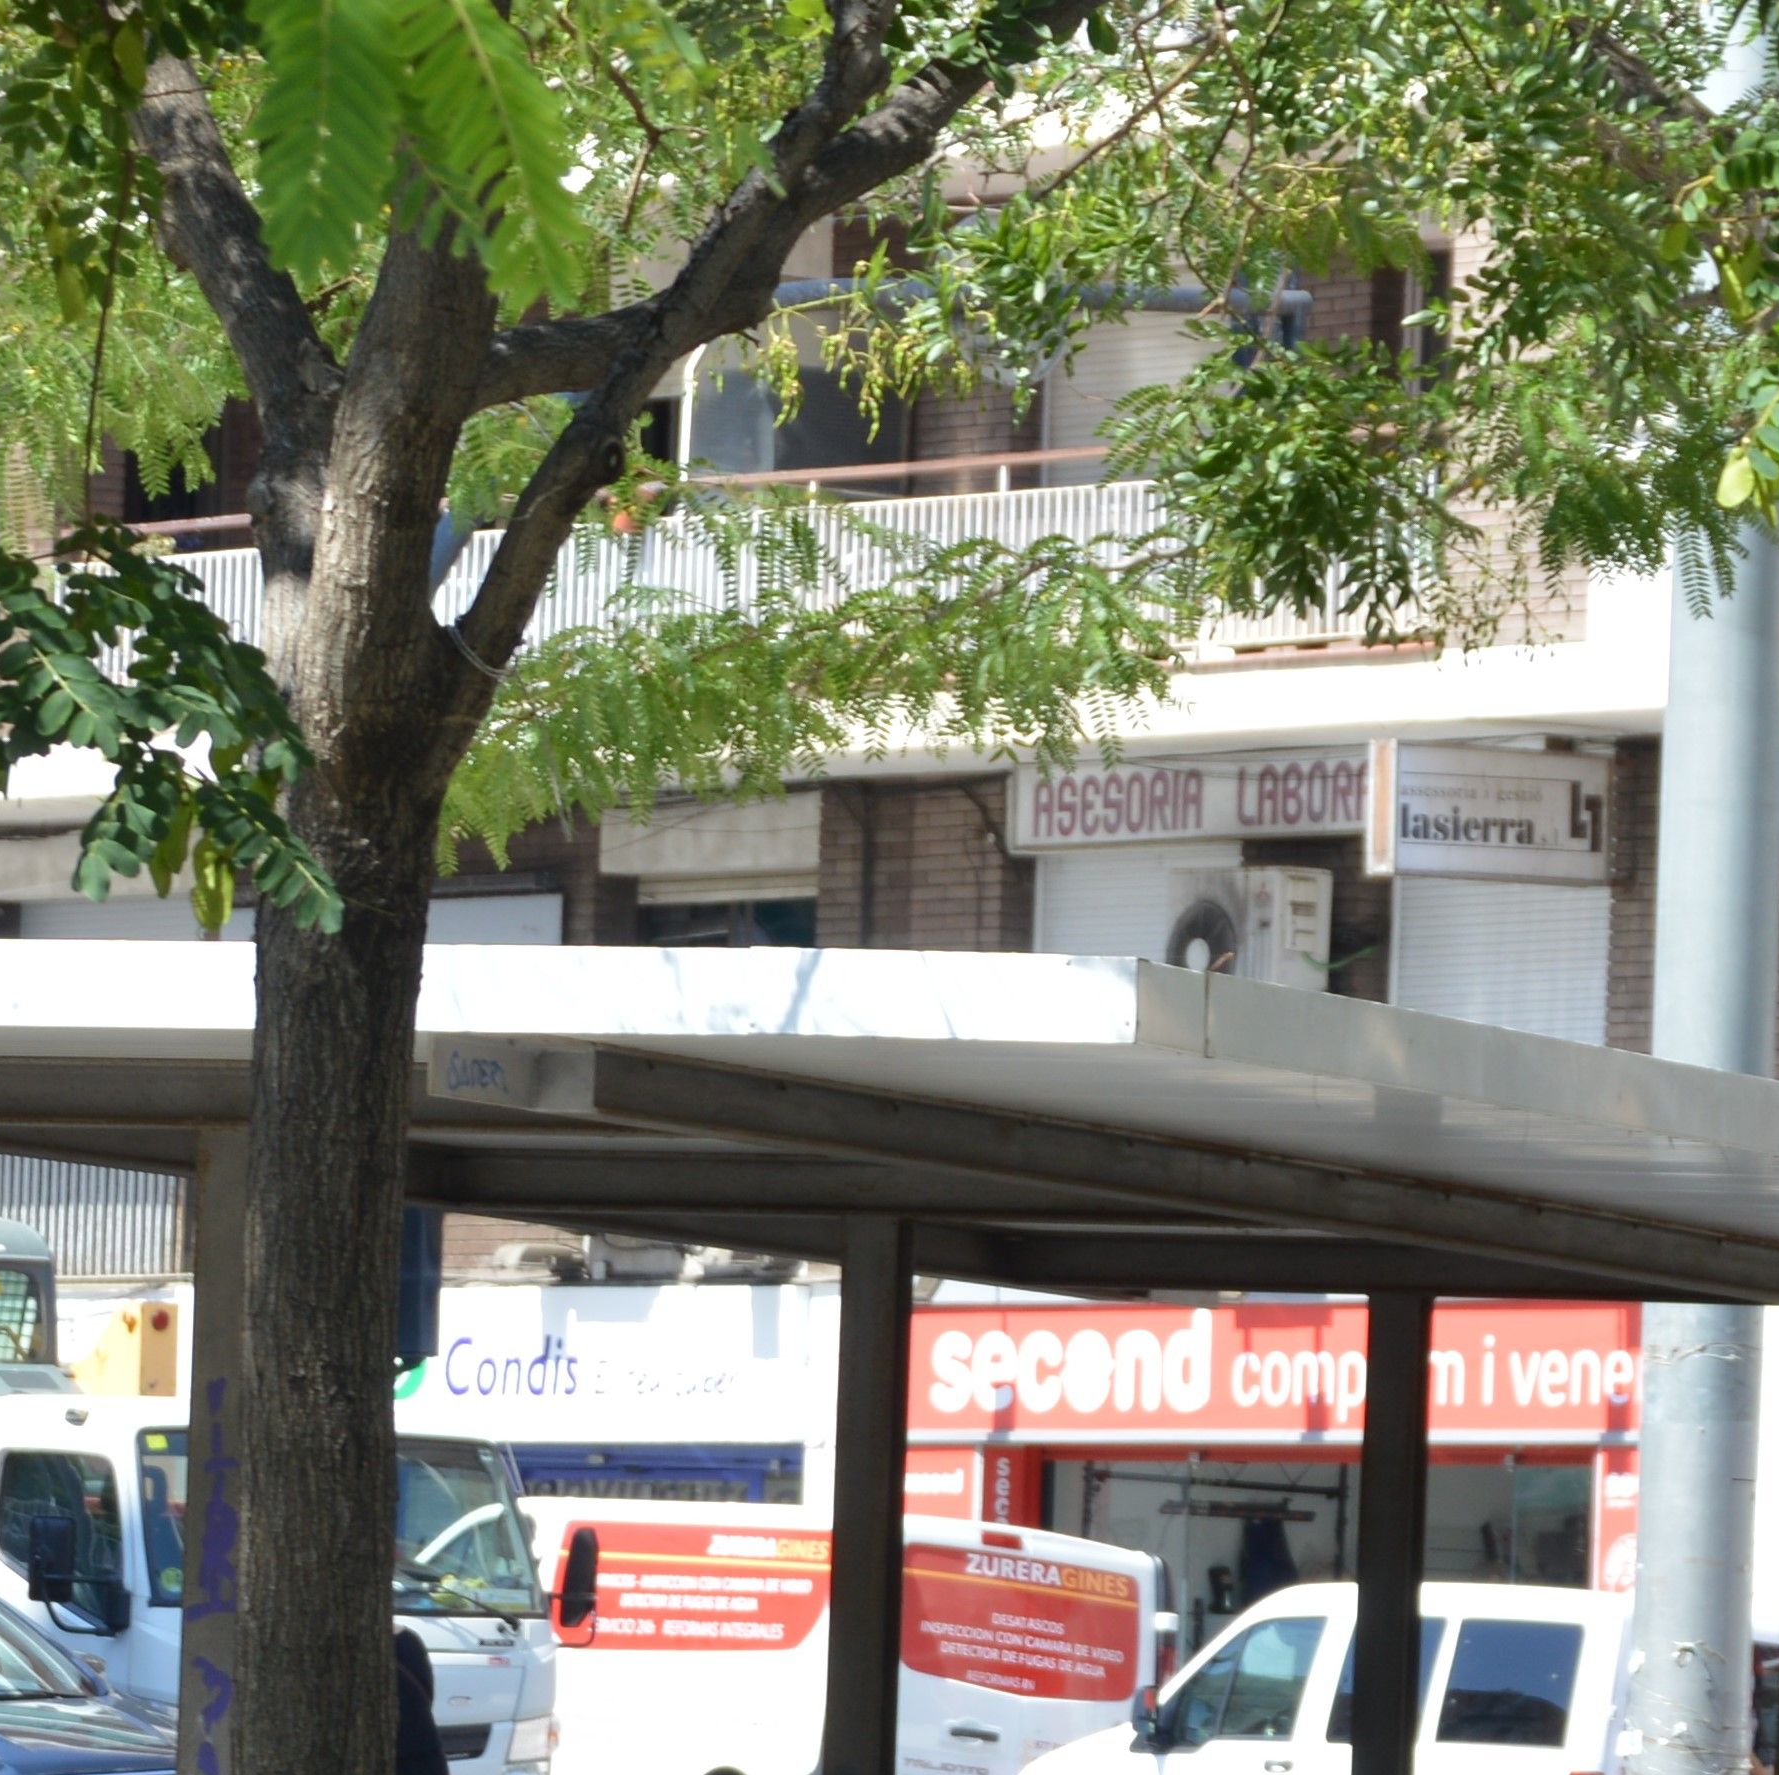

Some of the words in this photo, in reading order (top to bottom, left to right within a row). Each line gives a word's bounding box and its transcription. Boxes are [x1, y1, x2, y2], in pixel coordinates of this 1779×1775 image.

[1033, 767, 1204, 838] ASESORIA
[1237, 759, 1369, 826] LABORA
[1400, 803, 1535, 845] lasierra
[445, 1334, 579, 1396] Condis
[929, 1308, 1213, 1414] second
[1482, 1333, 1497, 1407] i
[991, 1611, 1065, 1636] DESATASCOS
[995, 1629, 1022, 1645] CON
[1075, 1643, 1091, 1657] DE
[939, 1640, 1000, 1661] DETECTOR
[1000, 1650, 1018, 1664] DE
[1058, 1658, 1074, 1673] DE
[1074, 1661, 1106, 1679] AGUA
